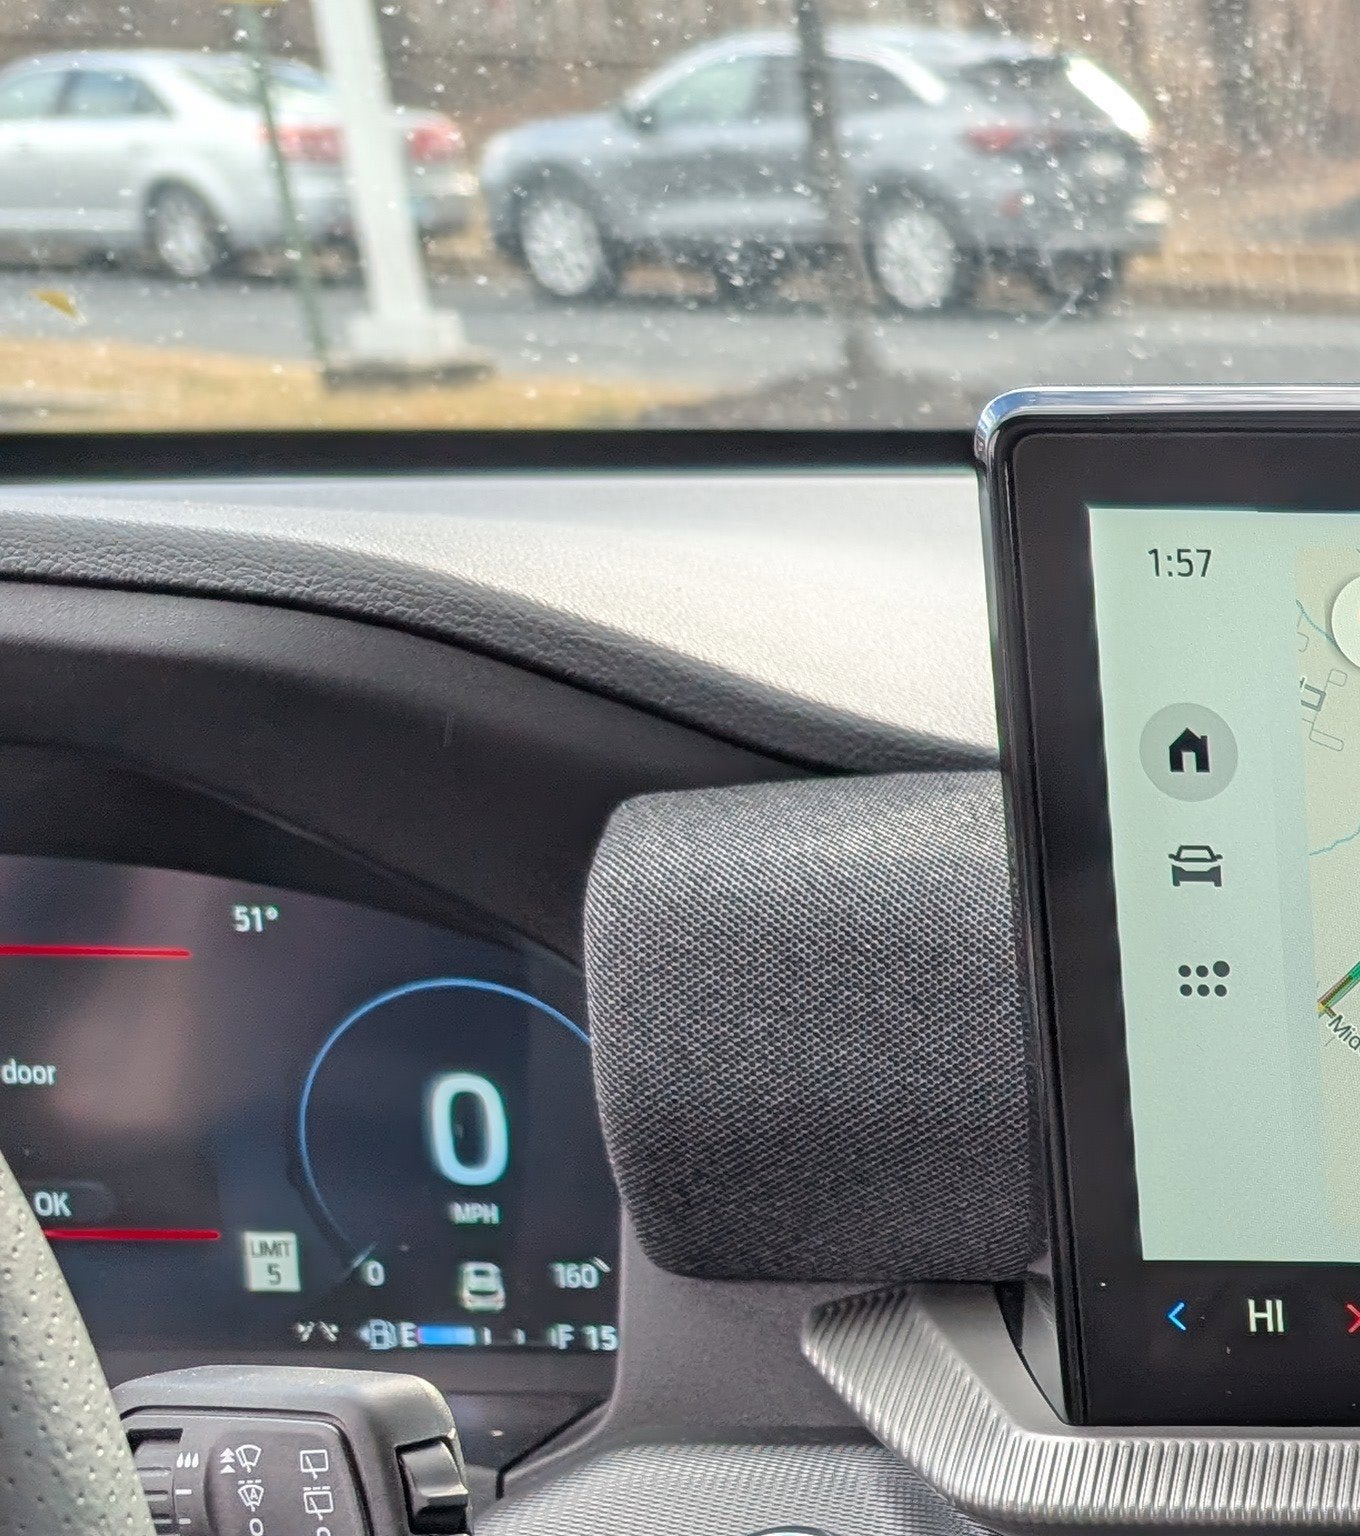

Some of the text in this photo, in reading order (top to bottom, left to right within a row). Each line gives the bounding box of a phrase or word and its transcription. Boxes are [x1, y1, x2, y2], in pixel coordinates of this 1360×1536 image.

[1147, 547, 1213, 579] 1:57
[0, 1058, 57, 1087] door
[431, 1072, 510, 1187] 0
[33, 1189, 73, 1217] OK
[450, 1201, 501, 1226] MPH
[250, 1238, 292, 1259] LIMIT
[266, 1263, 282, 1286] 5
[552, 1261, 600, 1290] 160
[1247, 1299, 1286, 1334] HI
